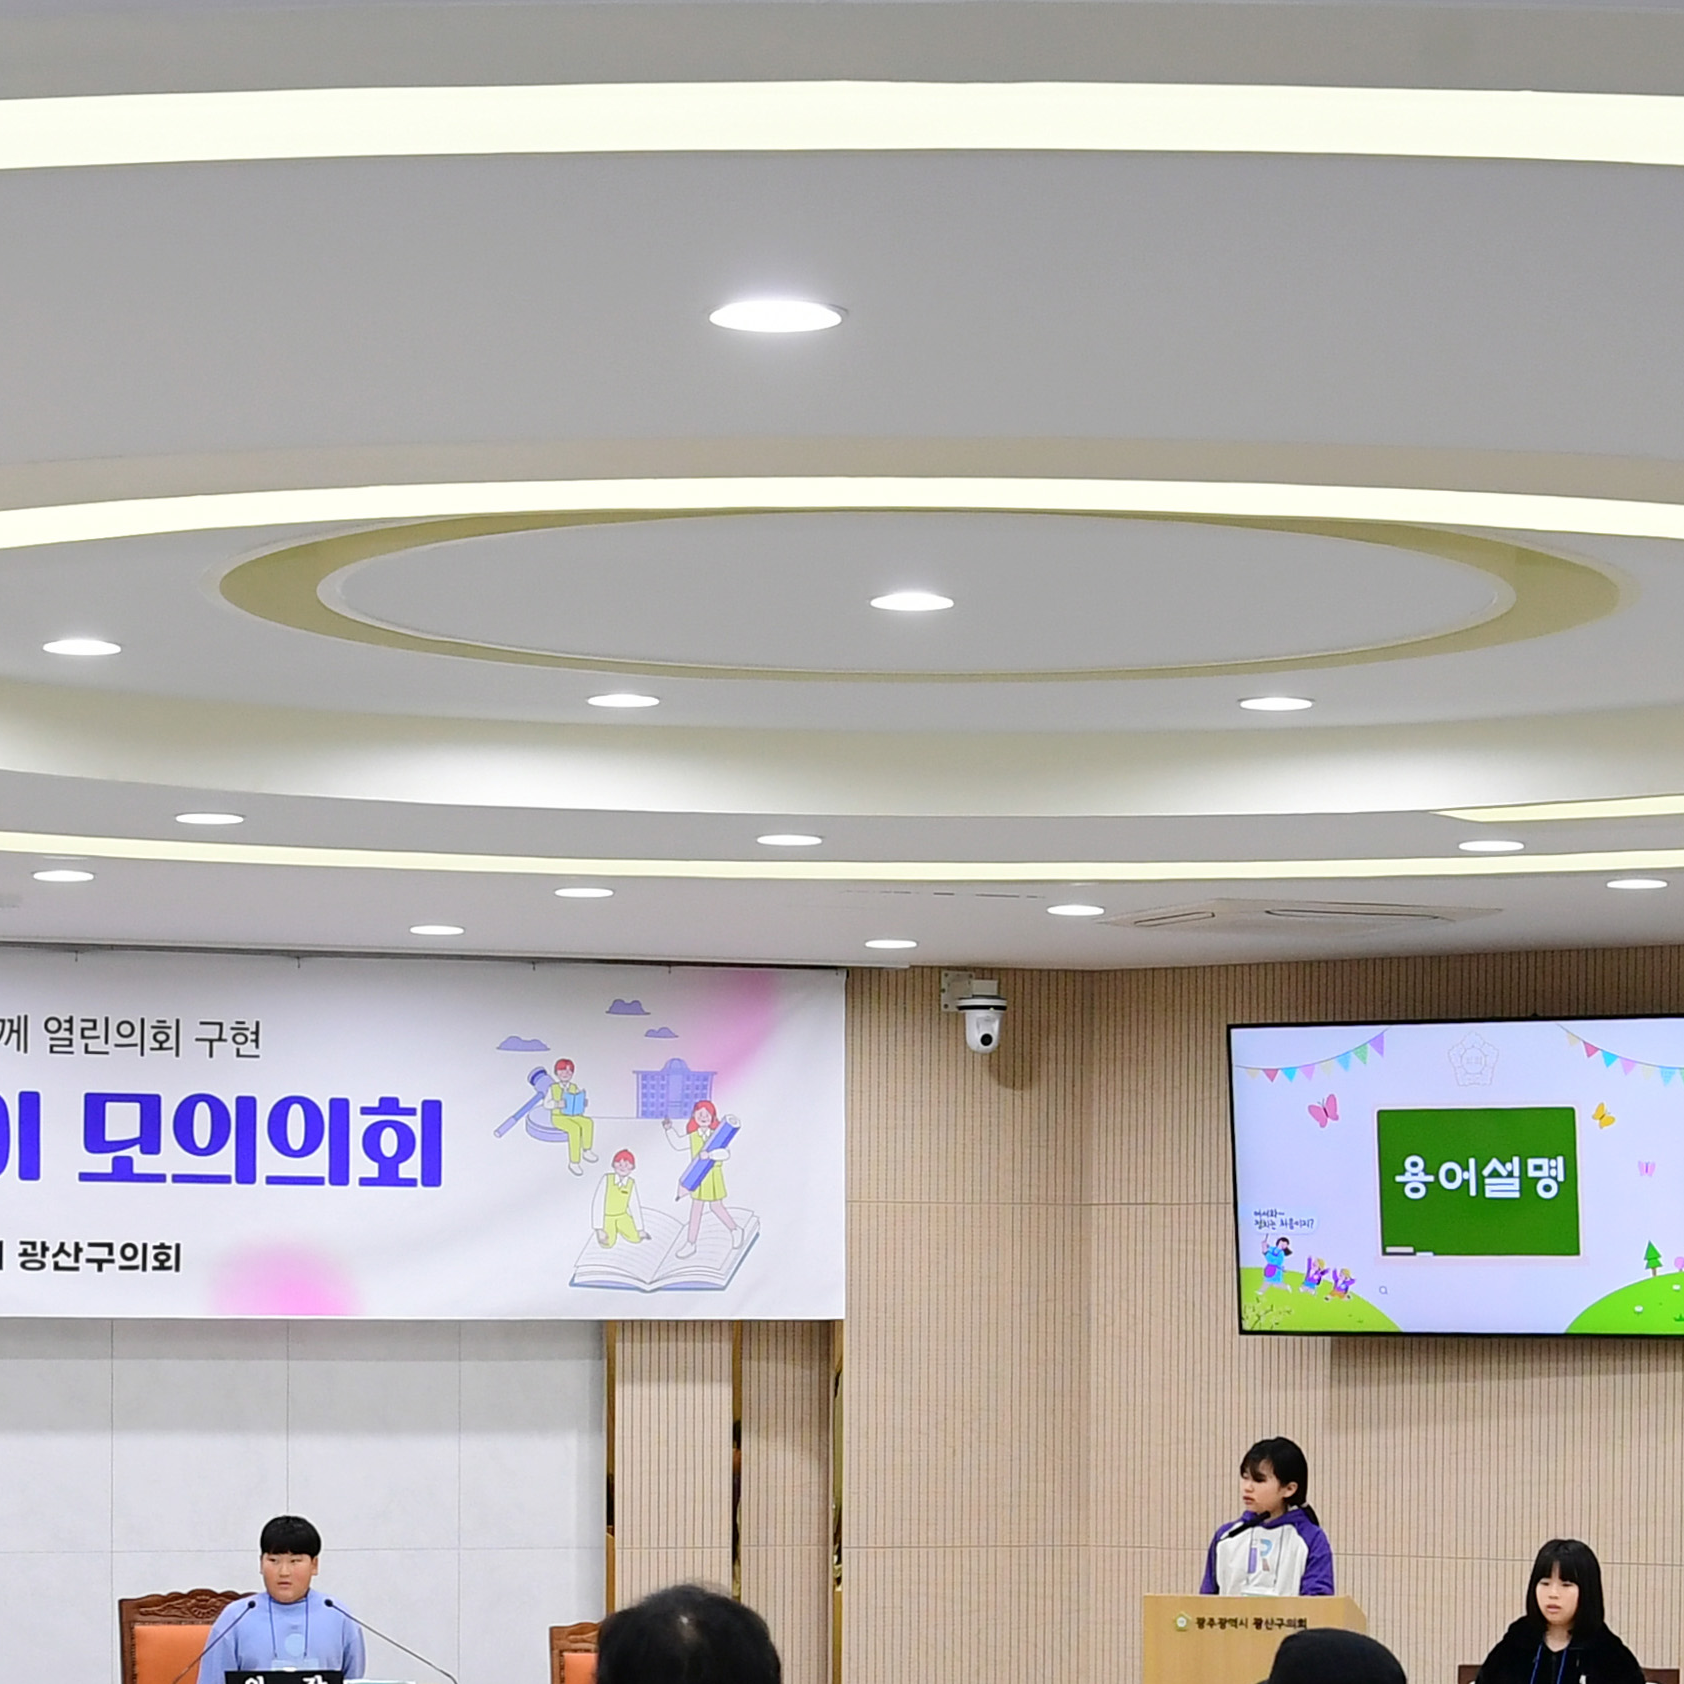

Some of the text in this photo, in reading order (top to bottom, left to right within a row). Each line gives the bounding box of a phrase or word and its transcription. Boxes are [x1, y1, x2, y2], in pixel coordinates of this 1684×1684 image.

[43, 1015, 181, 1058] 열린의회
[194, 1021, 261, 1059] 구현
[78, 1092, 443, 1188] 모의의회
[1394, 1154, 1565, 1200] 용어설명
[18, 1240, 182, 1273] 광산구의회
